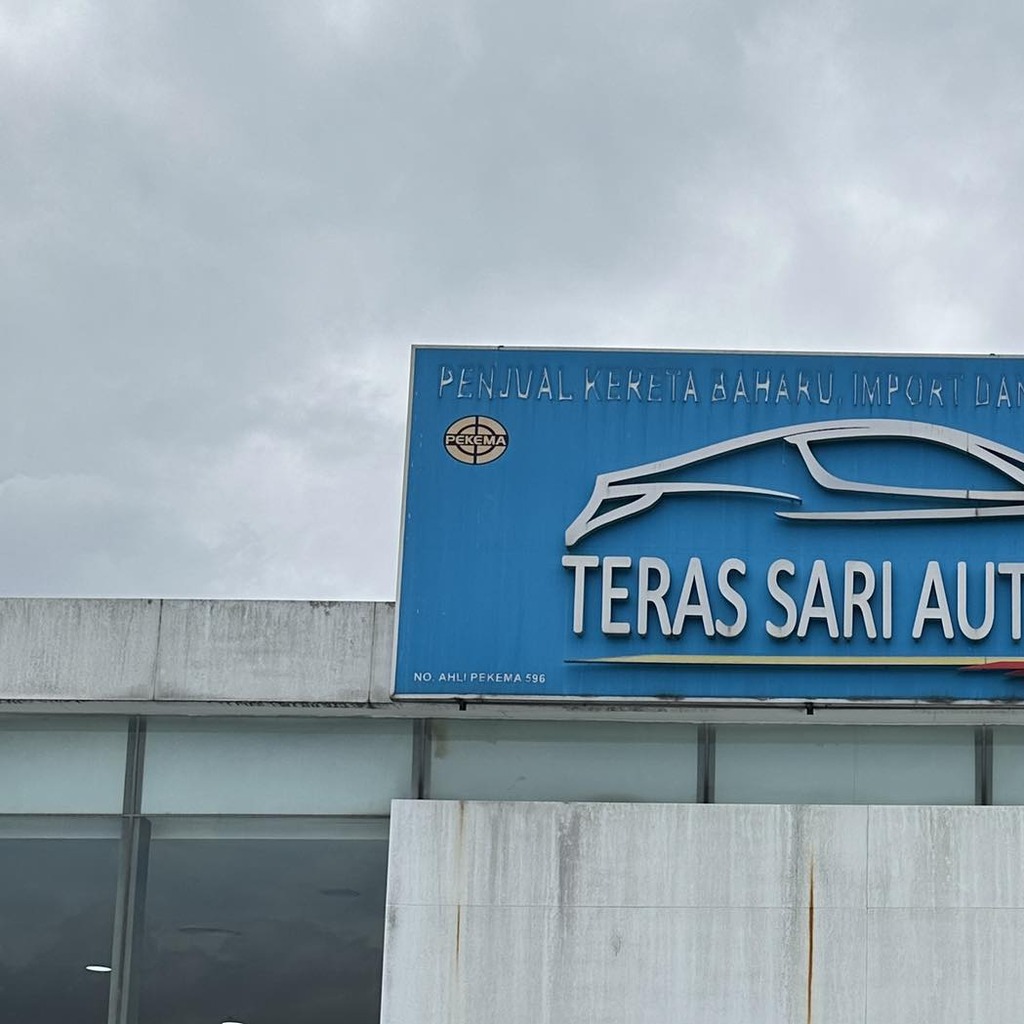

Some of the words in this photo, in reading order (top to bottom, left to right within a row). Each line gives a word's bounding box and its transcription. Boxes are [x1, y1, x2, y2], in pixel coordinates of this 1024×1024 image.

[438, 366, 573, 400] PENJUAL
[584, 368, 699, 402] KERETA
[852, 373, 965, 406] IMPORT
[445, 435, 507, 446] PEKEMA
[561, 555, 748, 637] TERAS
[765, 558, 892, 639] SARI
[413, 672, 435, 682] NO.
[438, 672, 467, 683] AHLI
[470, 673, 522, 683] PEKEMA
[525, 673, 546, 684] 596
